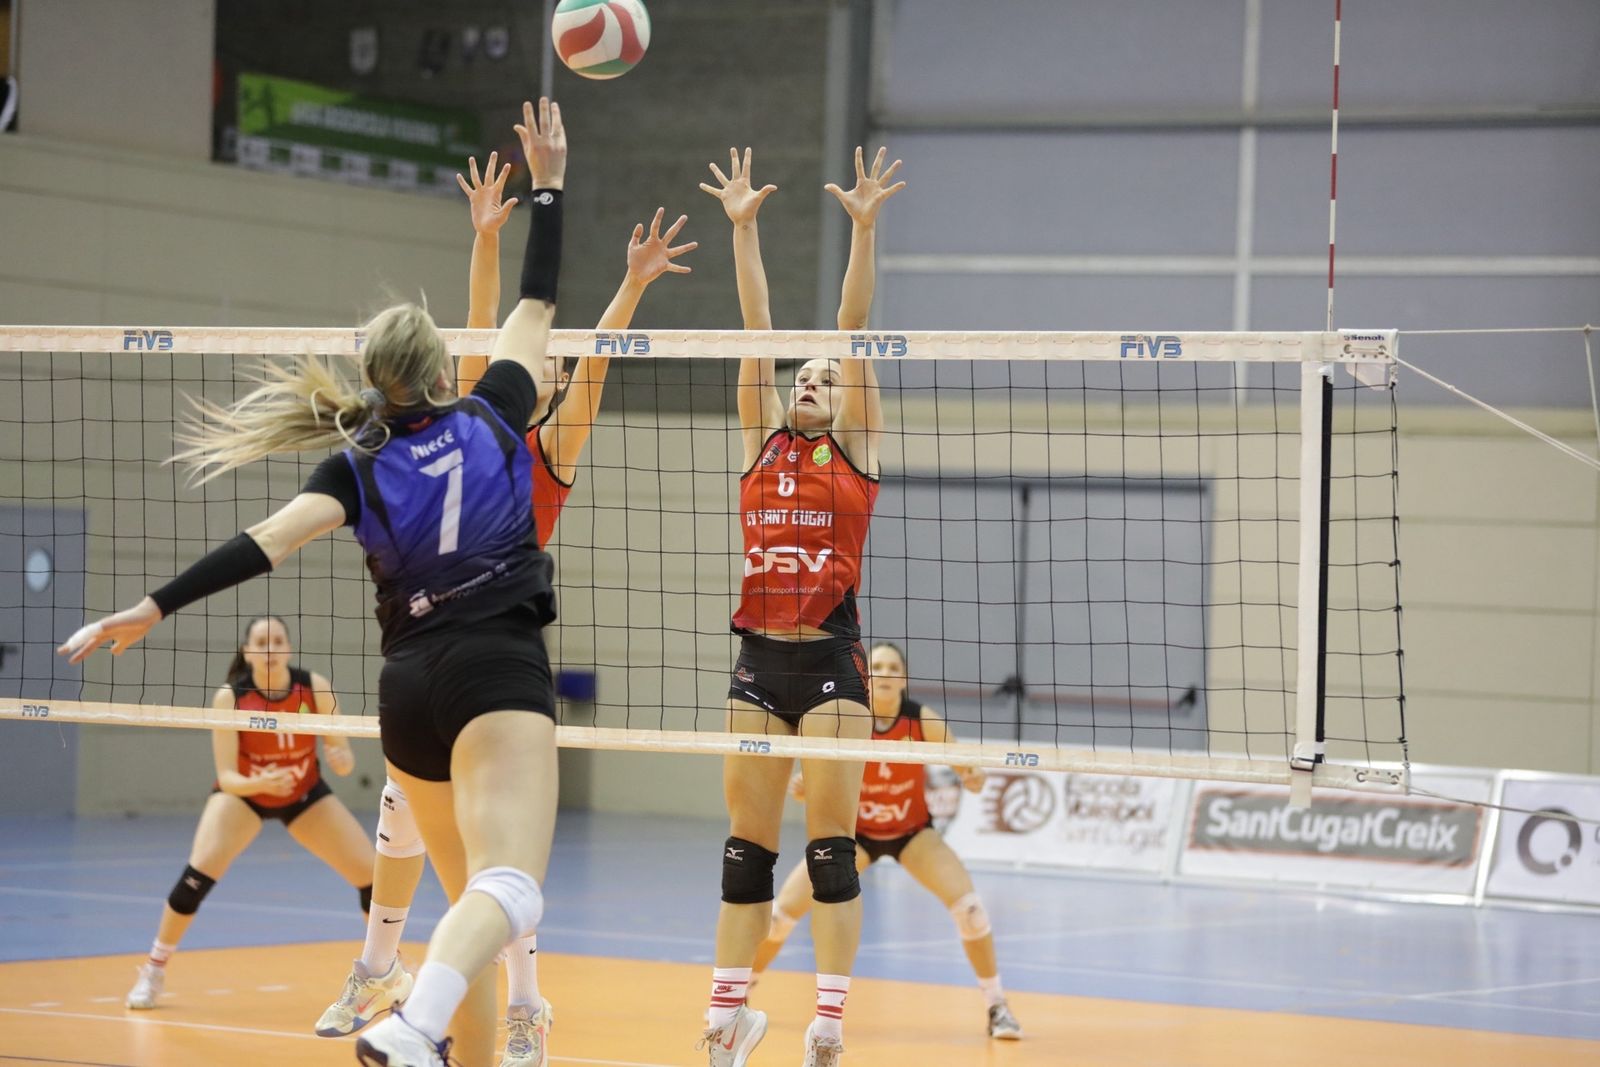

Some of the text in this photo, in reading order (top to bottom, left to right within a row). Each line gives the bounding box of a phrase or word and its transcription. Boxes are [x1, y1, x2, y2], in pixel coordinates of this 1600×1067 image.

[777, 471, 796, 497] 6
[418, 448, 464, 556] 7
[758, 508, 789, 525] SANT
[791, 508, 834, 528] CUGAT
[744, 545, 834, 578] DSV
[1205, 797, 1460, 853] SantCugatCreix
